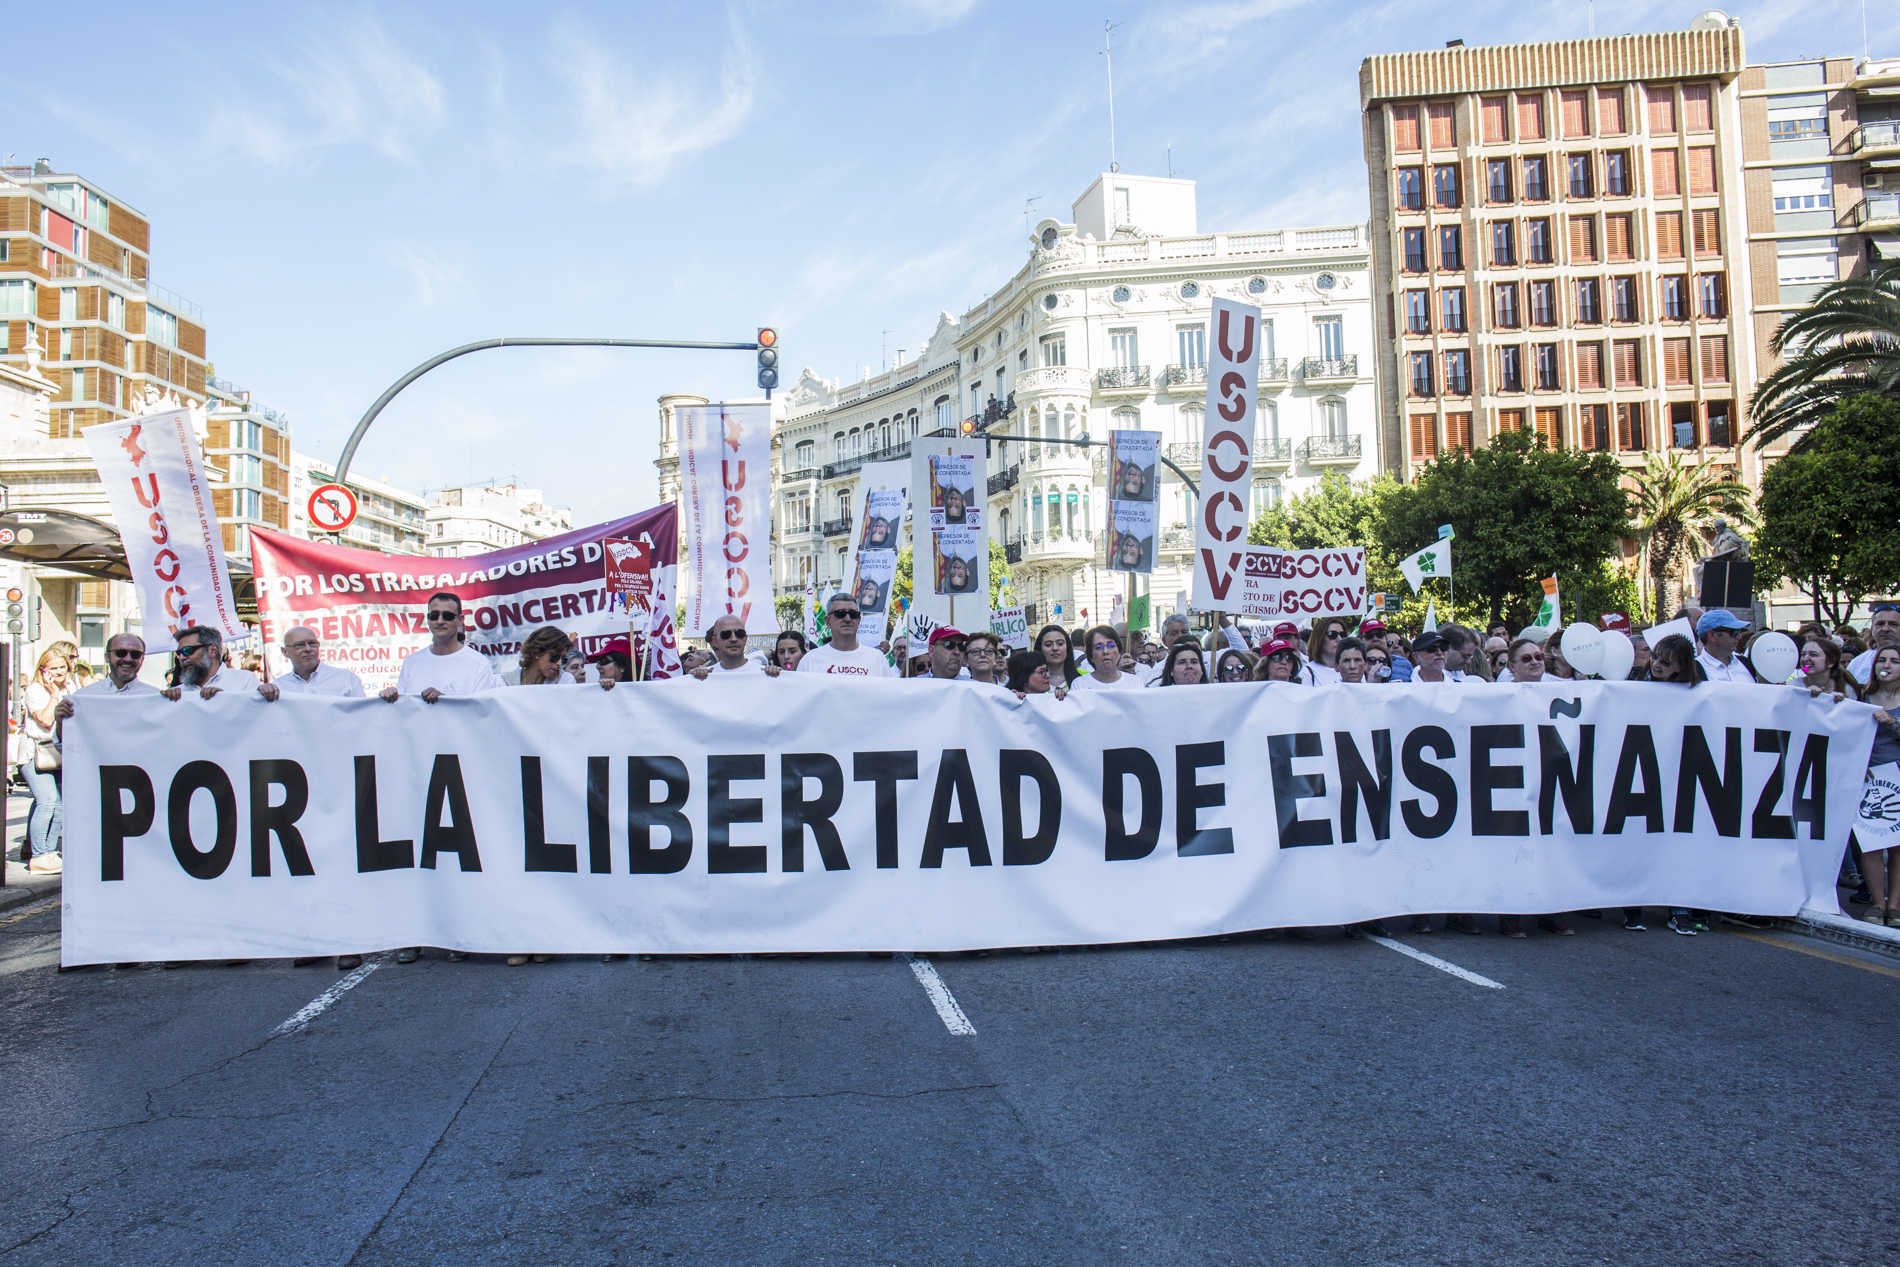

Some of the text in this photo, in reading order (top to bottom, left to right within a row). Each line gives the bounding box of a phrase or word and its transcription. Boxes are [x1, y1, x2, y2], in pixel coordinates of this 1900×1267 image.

[1200, 309, 1254, 600] USOCV
[205, 544, 221, 591] COMUNIDAD
[256, 575, 314, 599] POR
[319, 572, 365, 594] LOS
[366, 545, 577, 592] TRABAJADORES
[582, 541, 603, 564] D
[1281, 552, 1364, 579] SOCV
[319, 645, 390, 662] ERACIÓN
[98, 697, 1830, 881] POR LA LIBERTAD DE ENSEÑANZA
